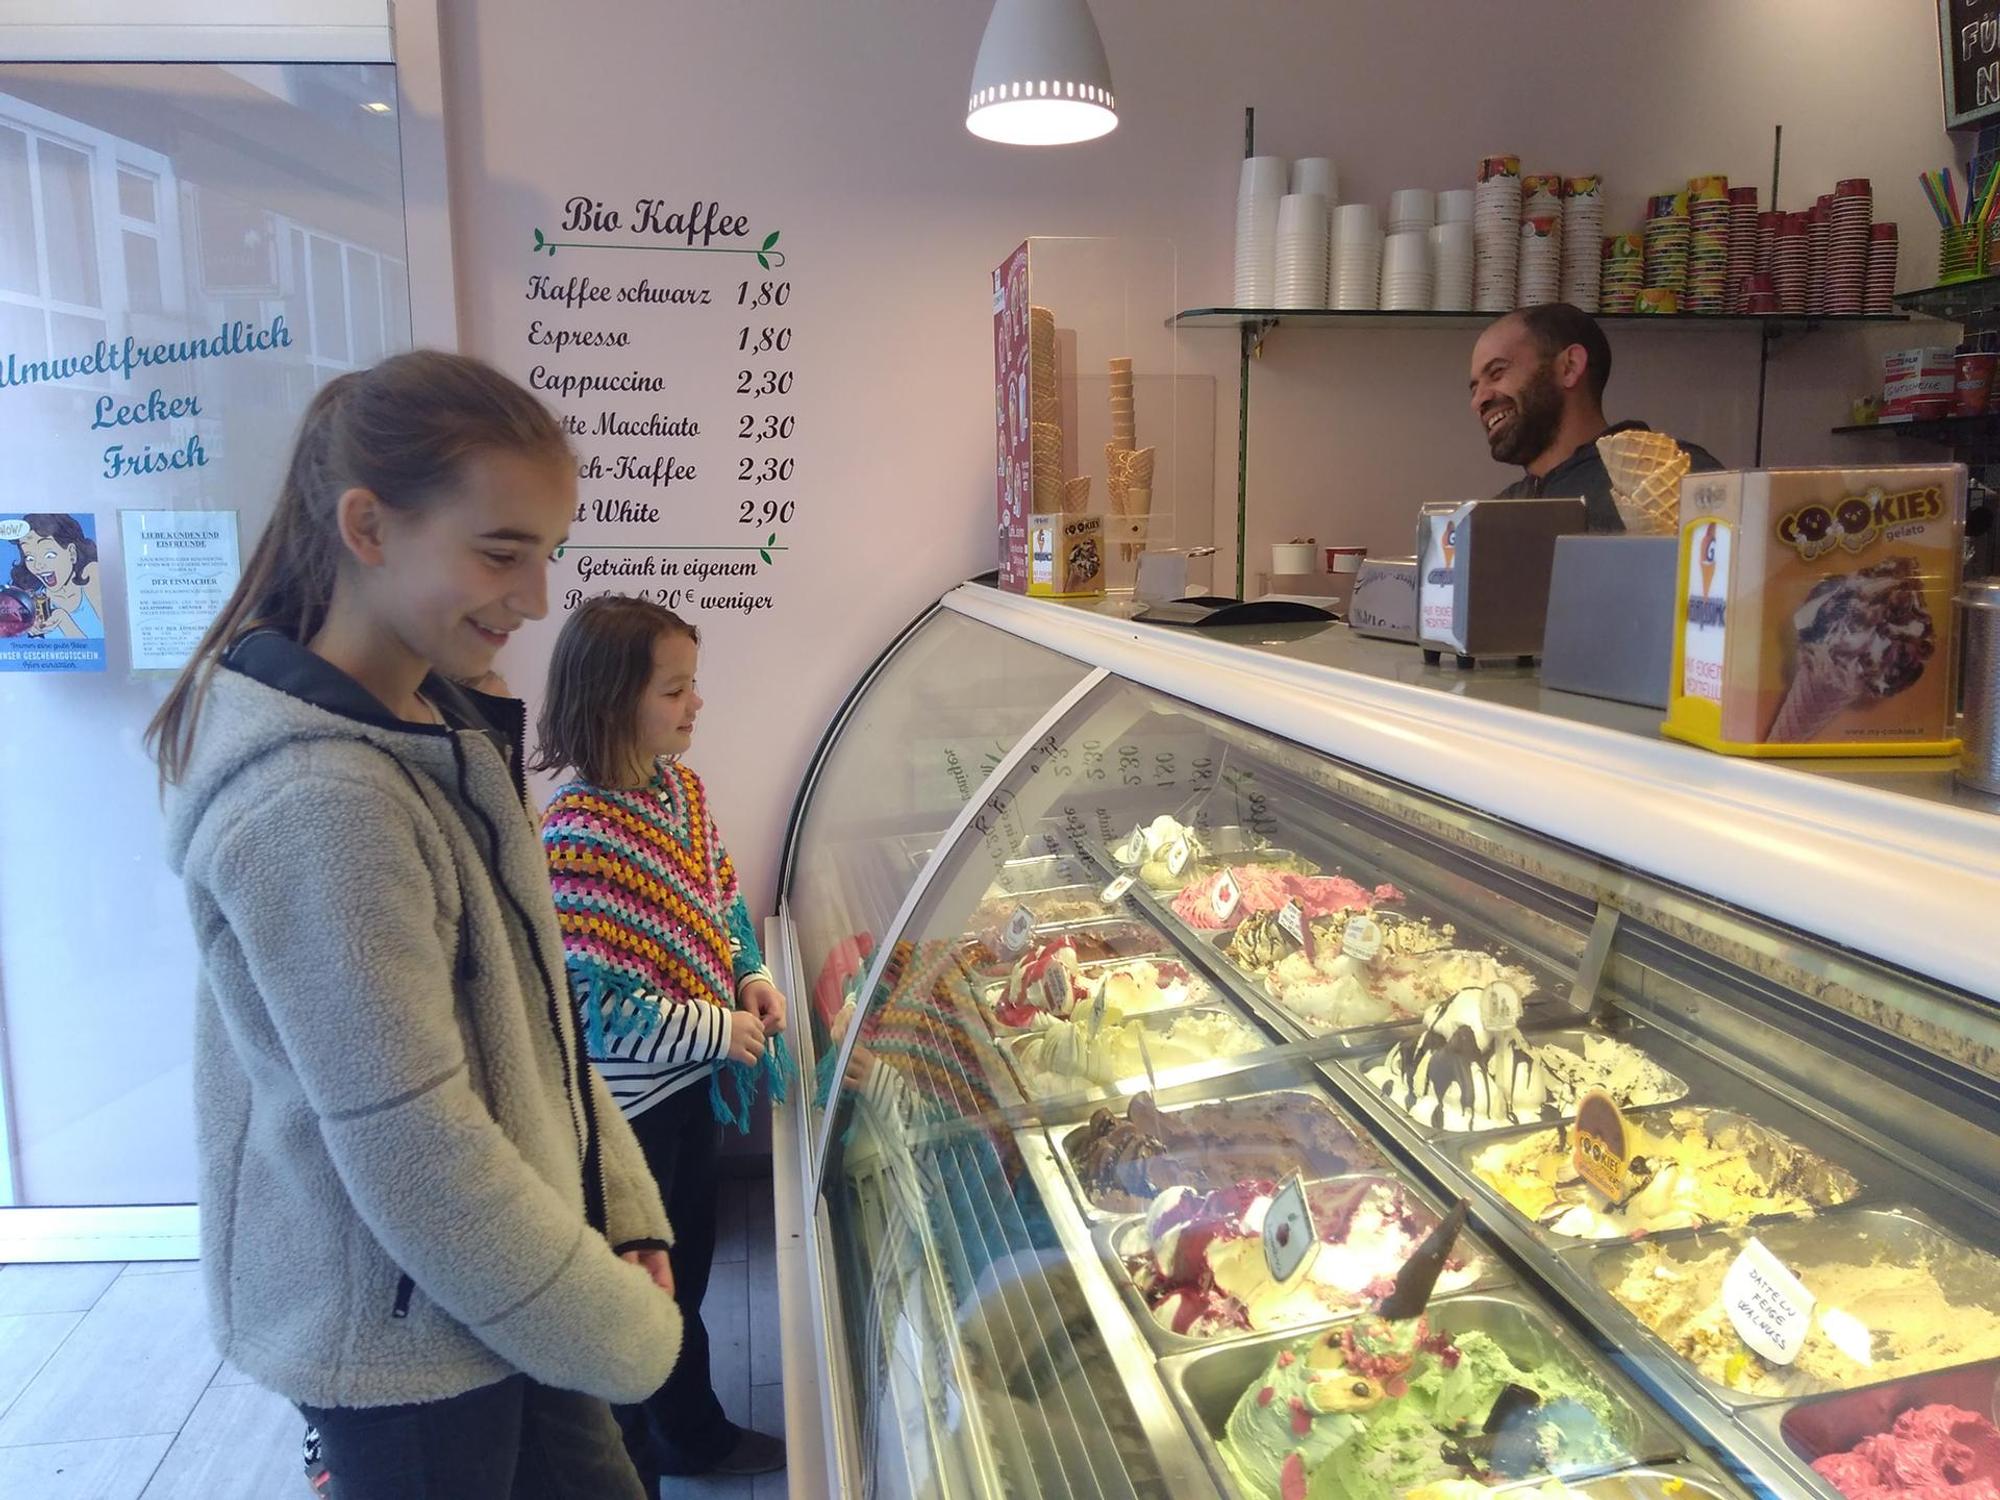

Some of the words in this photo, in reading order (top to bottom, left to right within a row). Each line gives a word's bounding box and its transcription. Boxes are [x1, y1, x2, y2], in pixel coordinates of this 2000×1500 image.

[1961, 12, 2000, 61] FÜ
[562, 196, 622, 232] Bio
[631, 199, 750, 246] Kaffee
[526, 275, 612, 309] Kaffee
[617, 279, 712, 305] schwarz
[737, 280, 791, 310] 1,80
[0, 315, 292, 388] Umweltfreundlich
[528, 320, 630, 353] Espresso
[738, 326, 792, 356] 1,80
[529, 365, 665, 397] Cappuccino
[736, 370, 794, 399] 2,30
[91, 388, 203, 431] Lecker
[592, 411, 700, 437] Macchiato
[738, 414, 795, 443] 2,30
[103, 434, 209, 479] Frisch
[577, 456, 697, 487] ch-Kaffee
[738, 457, 795, 487] 2,30
[592, 499, 660, 523] White
[739, 500, 795, 528] 2,90
[1778, 487, 1940, 543] COOKIES
[1886, 525, 1926, 542] gelato
[577, 556, 656, 582] Getränk
[660, 559, 680, 576] in
[683, 560, 758, 582] eigenem
[701, 591, 774, 616] weniger
[1579, 1134, 1620, 1174] COOKIES
[1748, 1268, 1797, 1317] DATTELN
[1752, 1293, 1786, 1326] FEIGE
[1737, 1299, 1788, 1351] WALNUSS
